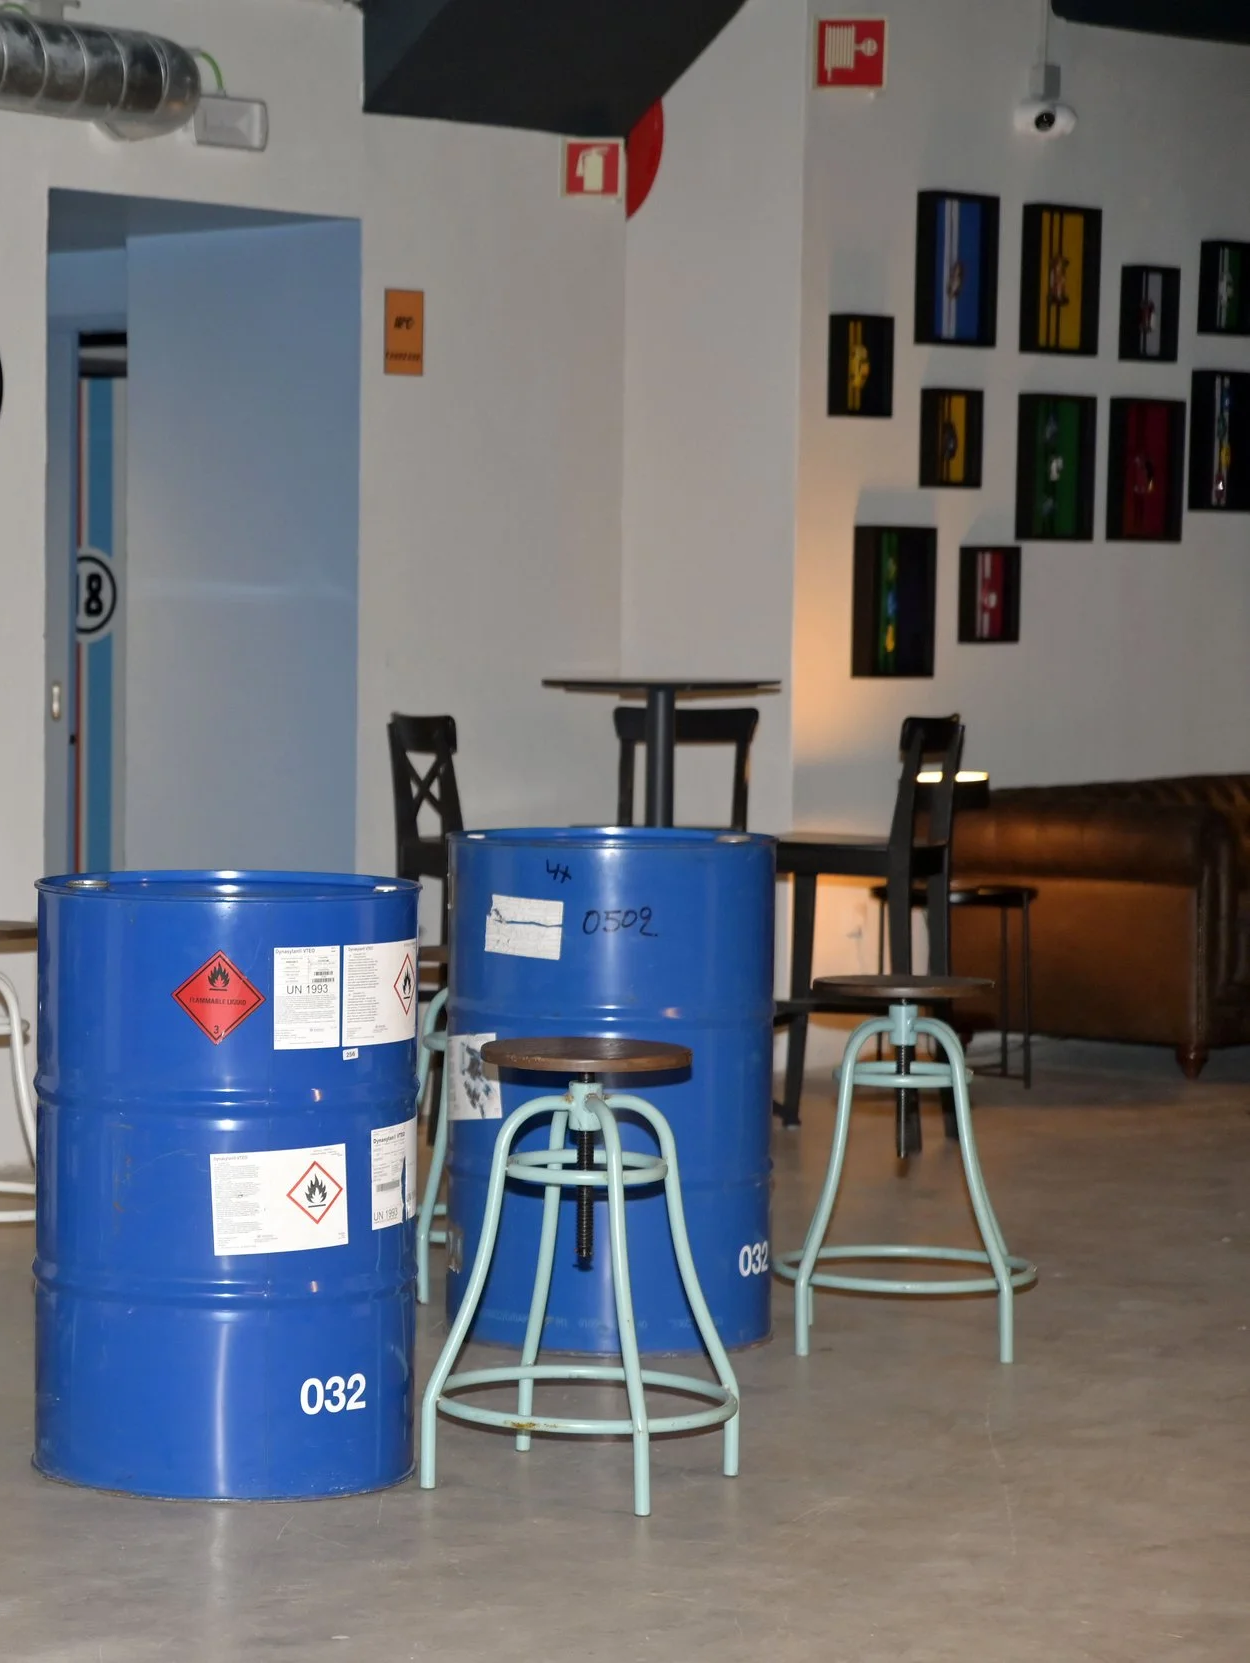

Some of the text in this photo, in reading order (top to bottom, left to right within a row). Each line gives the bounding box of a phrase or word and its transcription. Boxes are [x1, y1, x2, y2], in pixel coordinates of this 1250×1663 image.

[286, 984, 328, 994] UN 1993
[213, 1025, 219, 1034] 3
[374, 1207, 398, 1221] UN 1993
[738, 1240, 768, 1277] 032
[300, 1373, 366, 1415] 032
